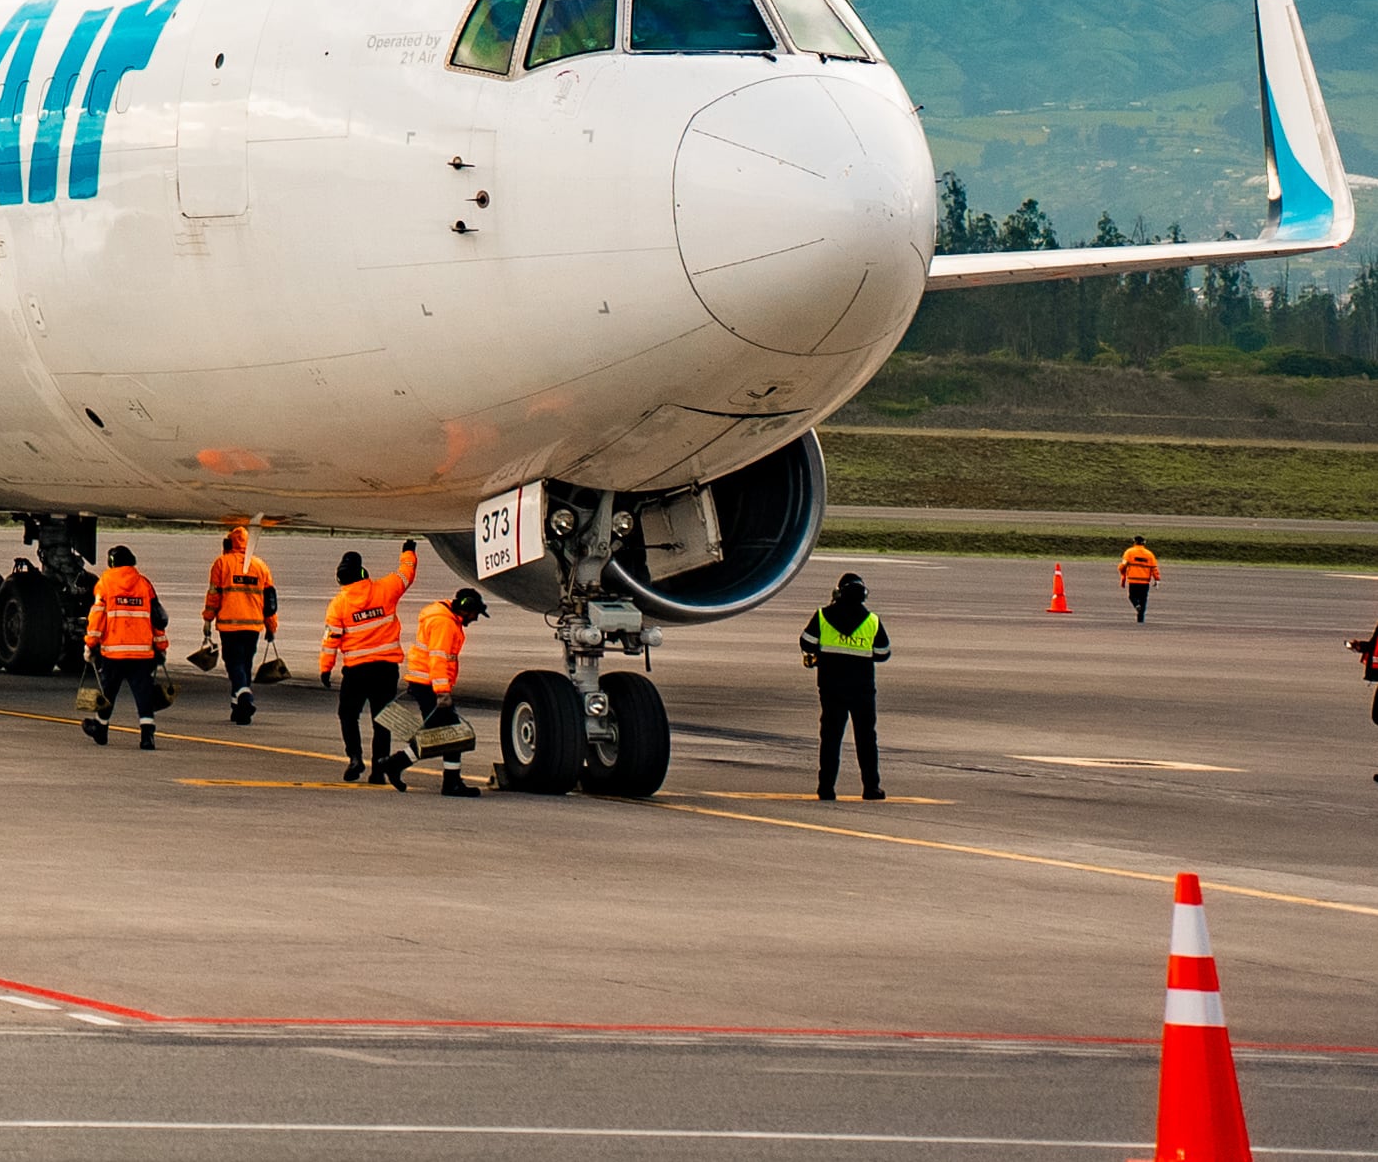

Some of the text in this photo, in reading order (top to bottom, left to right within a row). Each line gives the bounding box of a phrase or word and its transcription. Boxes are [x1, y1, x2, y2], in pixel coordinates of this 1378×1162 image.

[367, 33, 442, 51] Operated by
[400, 50, 437, 64] 21 Air
[481, 506, 510, 543] 373
[484, 548, 511, 570] ETOPS
[839, 634, 866, 646] MNT
